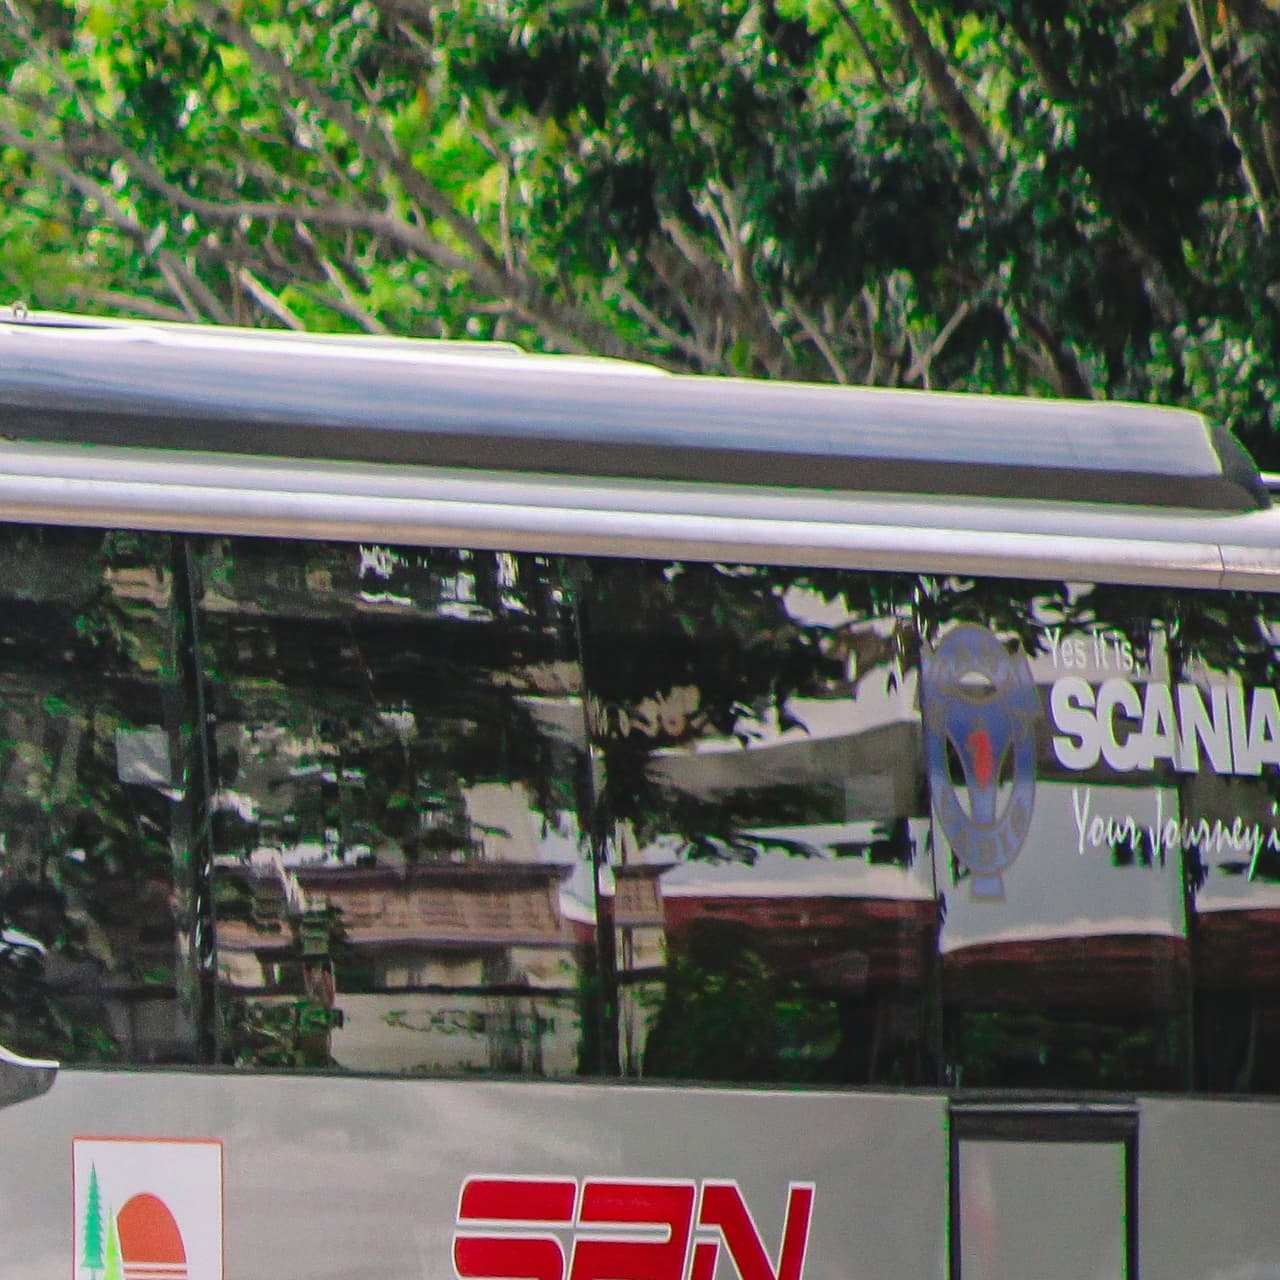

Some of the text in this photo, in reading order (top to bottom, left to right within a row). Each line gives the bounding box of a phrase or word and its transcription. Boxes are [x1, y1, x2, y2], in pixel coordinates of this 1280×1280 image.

[1044, 627, 1086, 669] Yes
[1051, 676, 1280, 775] SCANIA
[1072, 787, 1141, 856] Your
[1149, 786, 1264, 883] Journey
